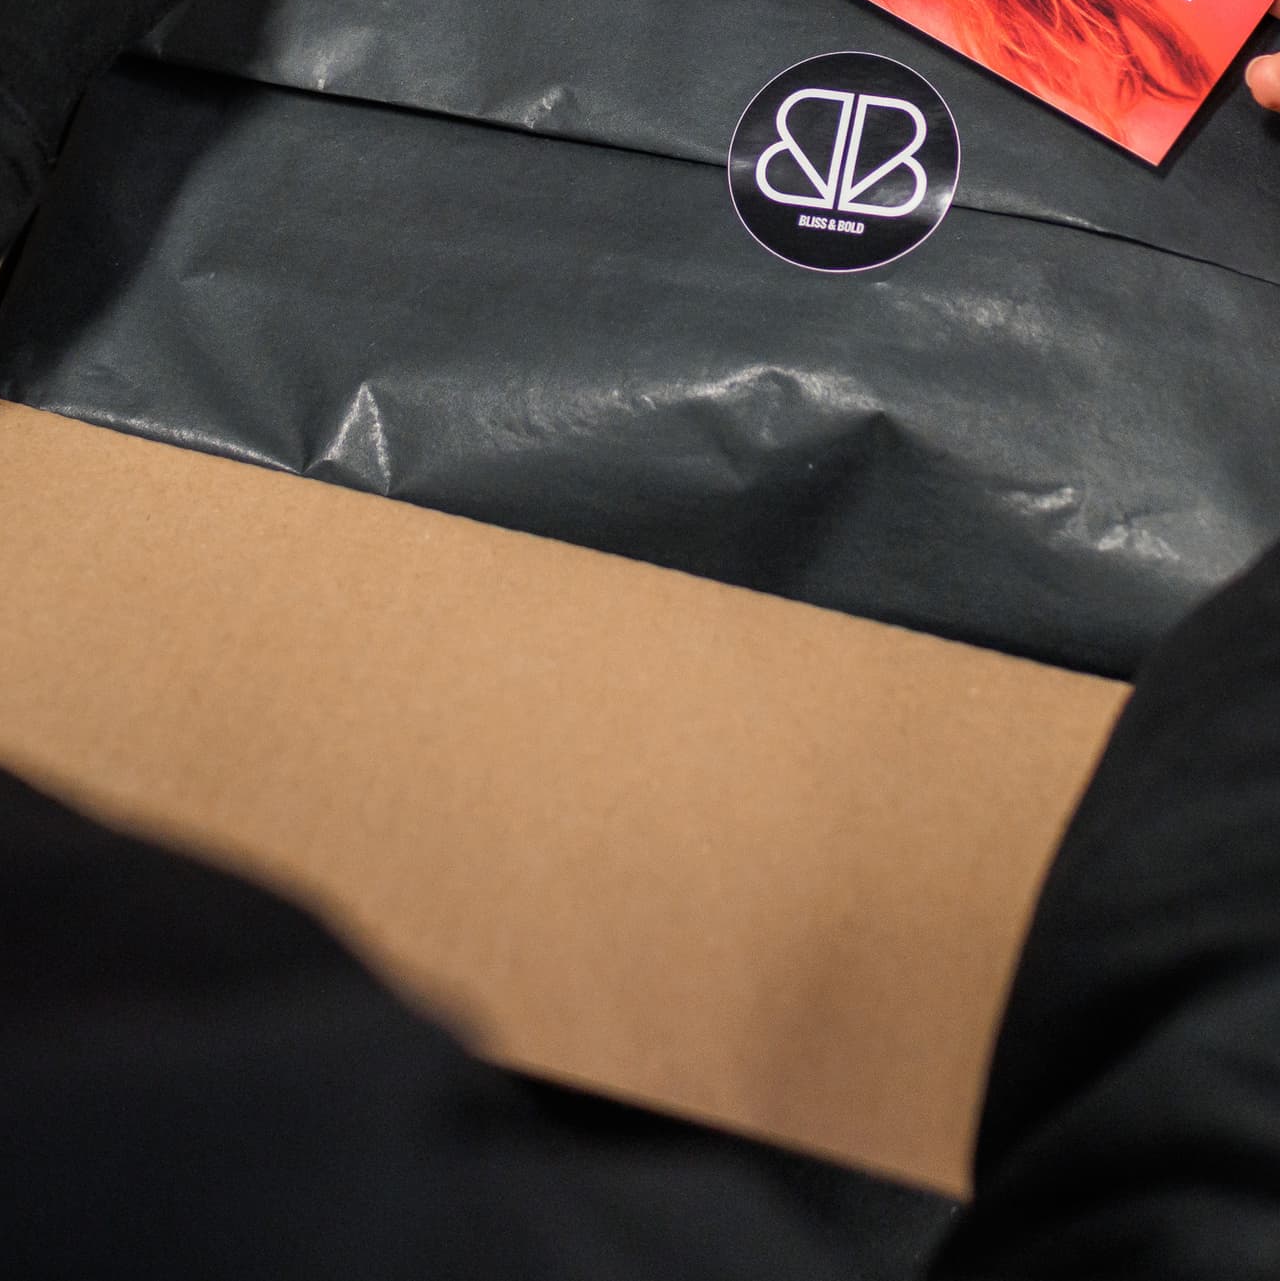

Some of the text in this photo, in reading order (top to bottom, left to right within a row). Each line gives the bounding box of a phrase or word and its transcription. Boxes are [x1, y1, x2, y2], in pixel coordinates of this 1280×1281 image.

[799, 215, 864, 234] BLISS & BOLD
